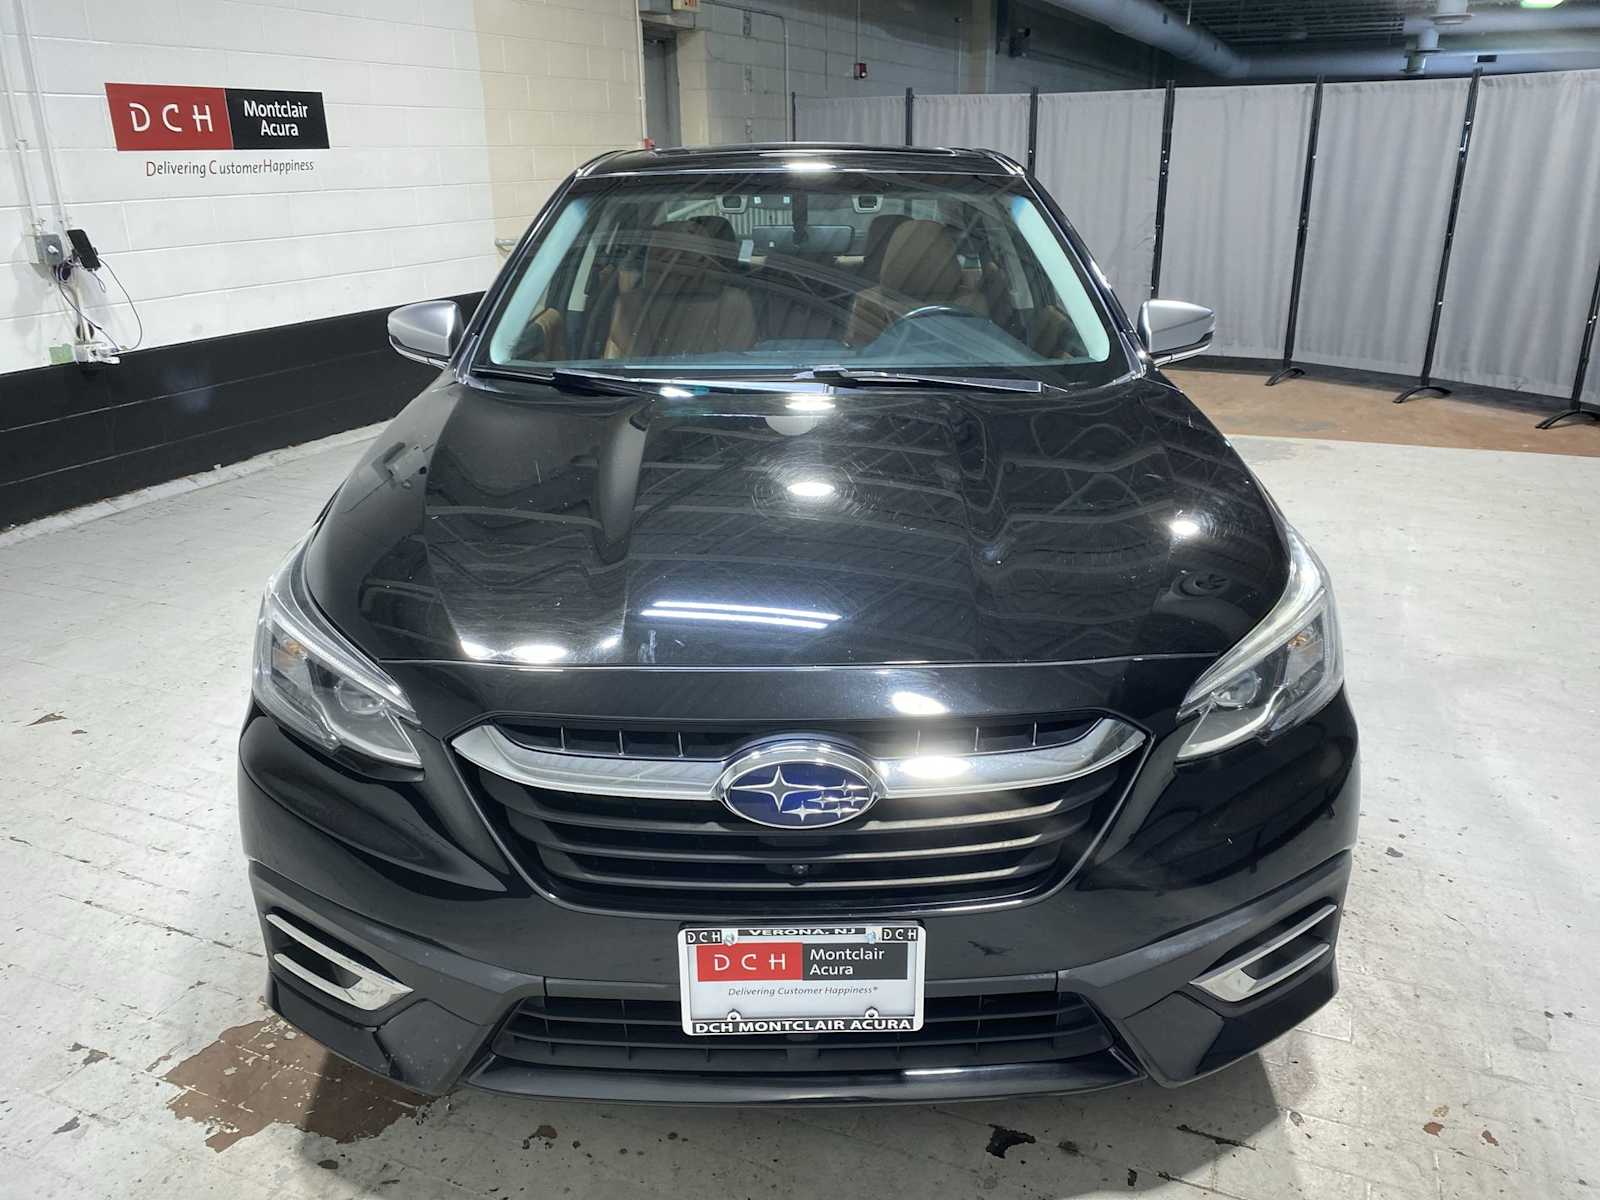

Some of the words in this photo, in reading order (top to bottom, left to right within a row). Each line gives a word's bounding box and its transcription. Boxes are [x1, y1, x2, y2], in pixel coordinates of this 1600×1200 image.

[244, 100, 309, 119] Montclair
[128, 102, 214, 133] DCH
[260, 119, 300, 137] Acura
[146, 160, 207, 178] Delivering
[687, 931, 722, 944] DCH
[883, 928, 918, 941] DCH
[809, 947, 886, 961] Montclair
[713, 952, 787, 972] DCH
[809, 964, 854, 976] Acura
[728, 987, 776, 997] Delivering
[777, 986, 823, 996] Customer
[695, 1021, 734, 1034] DCH
[738, 1020, 845, 1033] MONTCLAIR
[850, 1019, 912, 1031] ACURA
